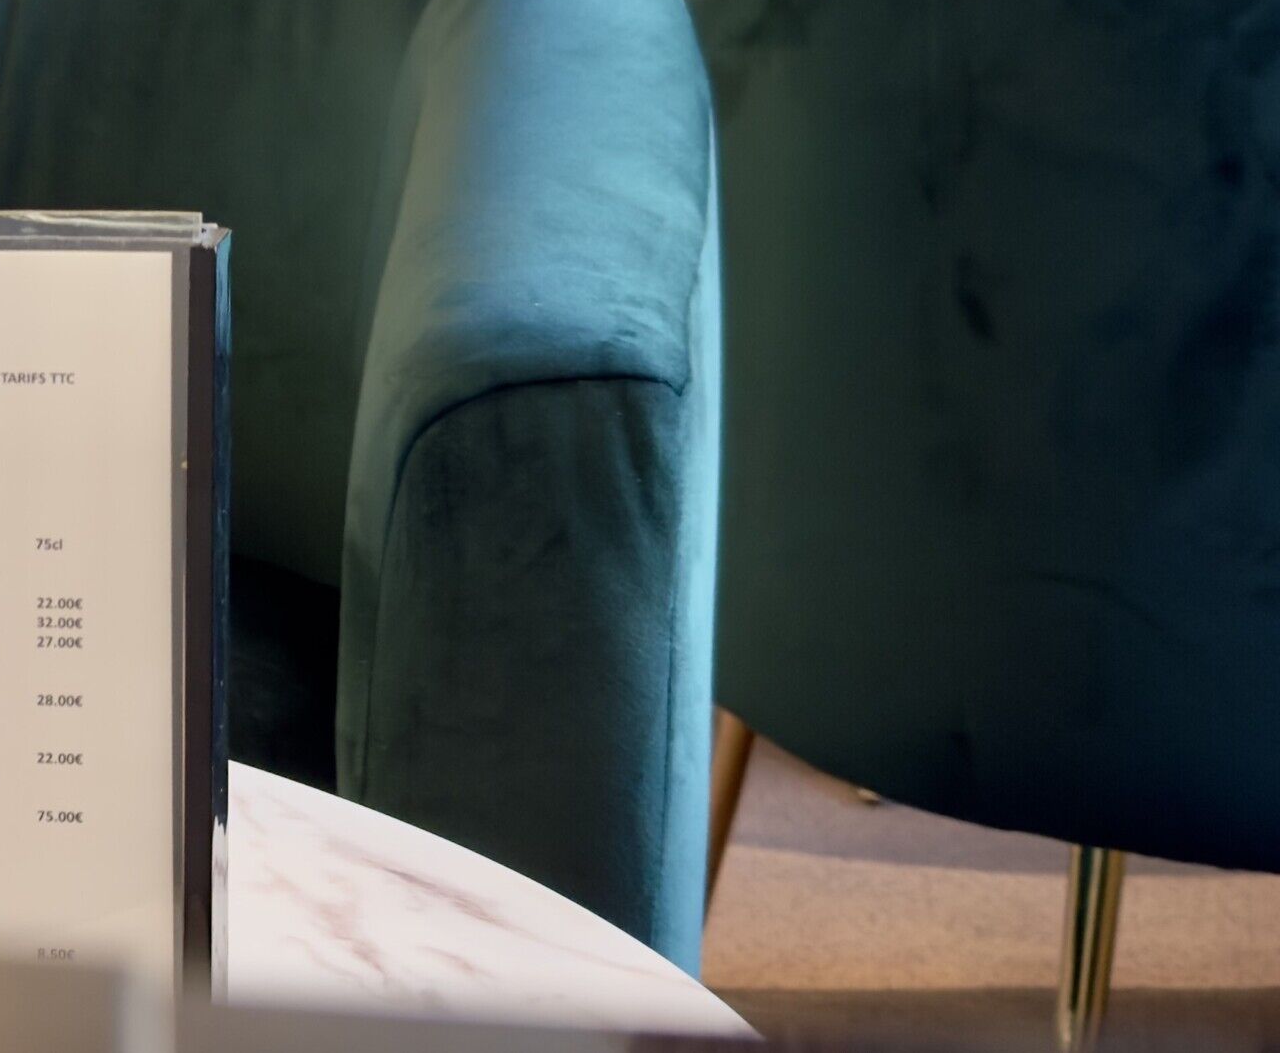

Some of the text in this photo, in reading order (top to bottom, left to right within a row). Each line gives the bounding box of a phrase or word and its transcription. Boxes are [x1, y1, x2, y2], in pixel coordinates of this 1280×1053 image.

[1, 372, 75, 385] TARIFS TTC
[35, 538, 63, 551] 75cl
[36, 597, 83, 610] 22.00€
[36, 617, 83, 630] 32.00€
[36, 636, 83, 649] 27.00€
[36, 694, 83, 707] 28.00€
[36, 752, 83, 765] 22.00€
[36, 810, 83, 823] 75.00€
